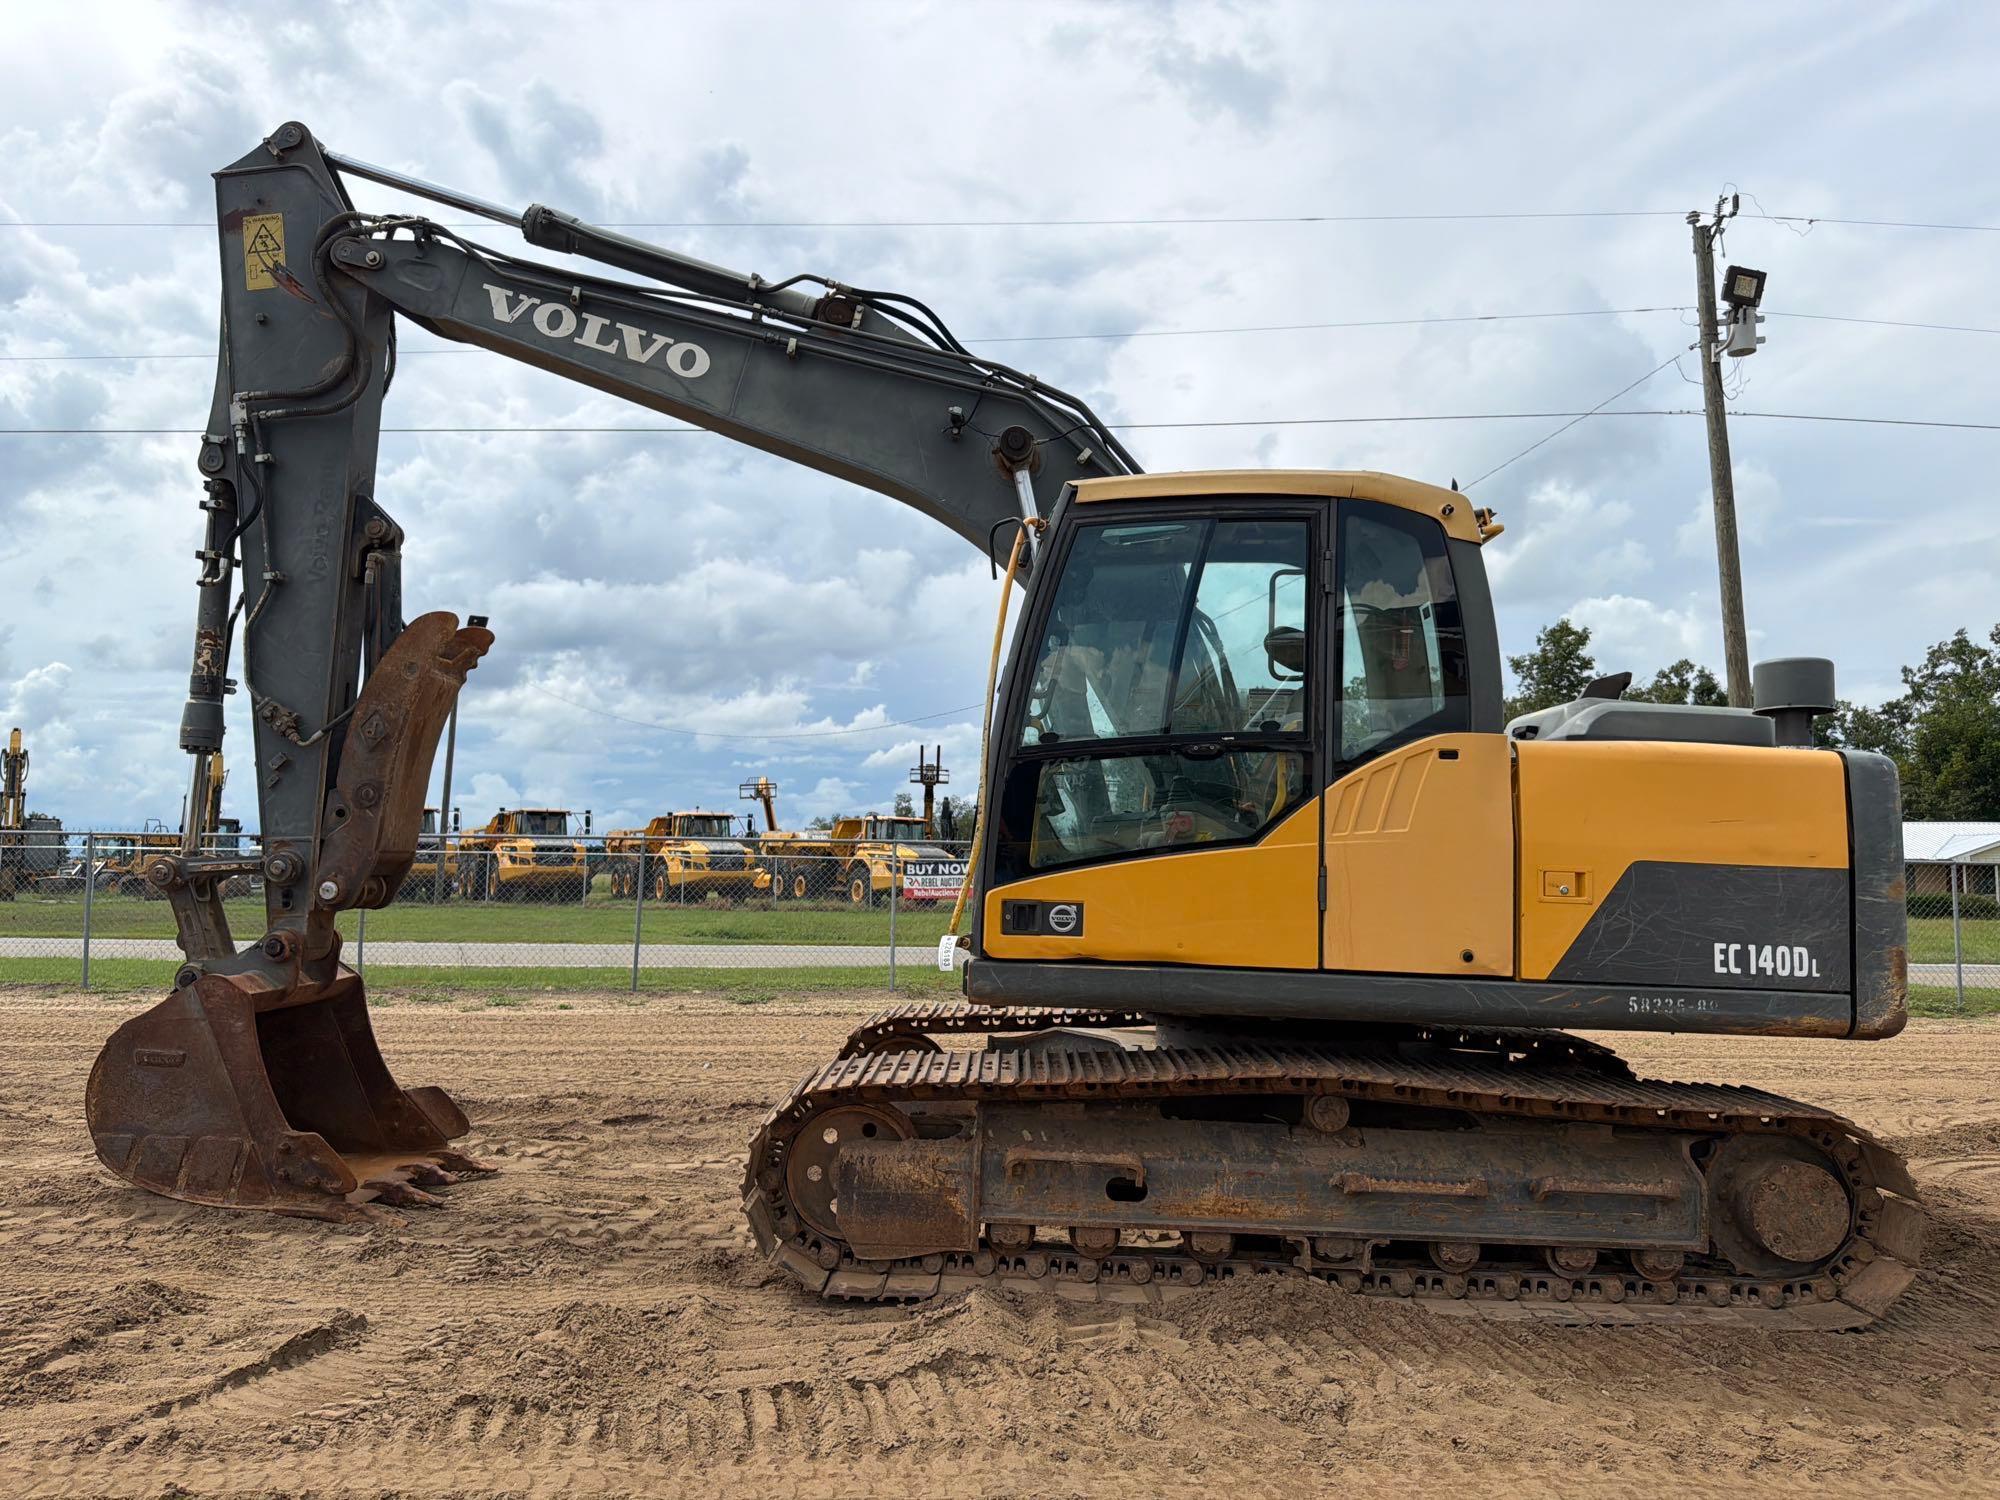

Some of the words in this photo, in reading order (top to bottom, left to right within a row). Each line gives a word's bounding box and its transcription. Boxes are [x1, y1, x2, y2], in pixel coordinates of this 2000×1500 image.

[482, 283, 711, 378] VOLVO
[906, 863, 934, 875] BUY
[921, 877, 938, 887] REBEL
